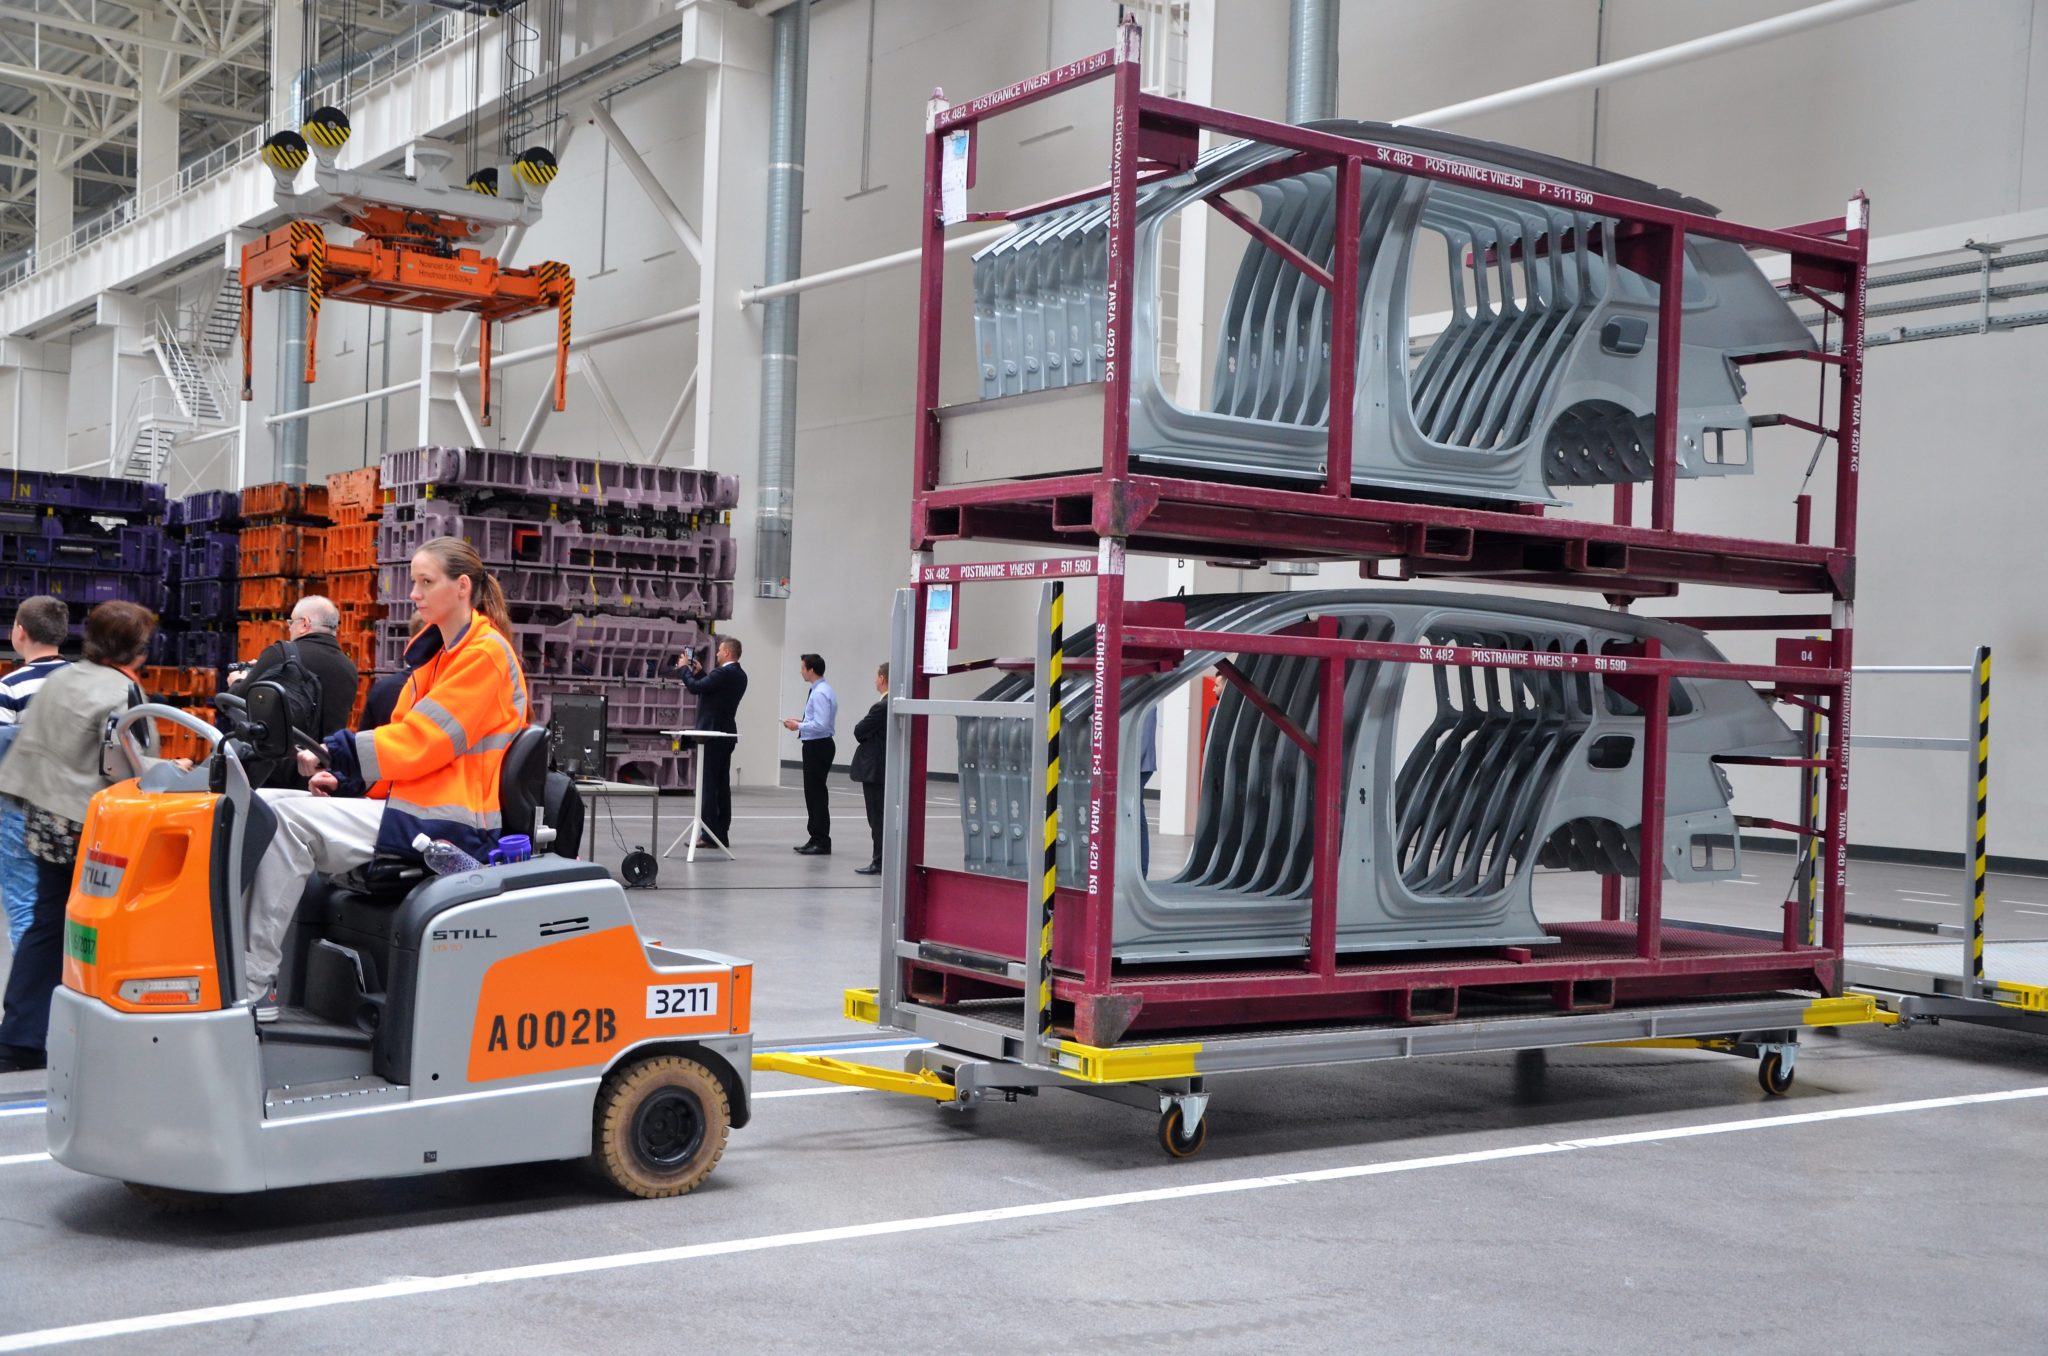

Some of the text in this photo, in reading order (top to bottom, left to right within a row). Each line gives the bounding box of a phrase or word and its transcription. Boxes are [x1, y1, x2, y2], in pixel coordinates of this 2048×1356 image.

[940, 111, 951, 124] SK
[952, 105, 967, 120] 482
[972, 84, 1021, 112] POSTRANICE
[1056, 70, 1064, 82] P
[1070, 62, 1087, 77] 511
[1089, 53, 1107, 71] 590
[1376, 147, 1390, 162] SK
[1392, 151, 1414, 167] 482
[1425, 158, 1488, 182] POSTRANICE
[1539, 183, 1546, 195] P
[1554, 187, 1572, 201] 511
[1575, 191, 1594, 206] 590
[1107, 280, 1117, 324] TARA
[1106, 328, 1116, 358] 420
[1106, 361, 1115, 382] KG
[1852, 392, 1861, 426] TARA
[1851, 429, 1860, 453] 420
[1850, 455, 1859, 472] KG
[20, 483, 31, 497] N
[924, 568, 934, 580] SK
[935, 567, 950, 580] 482
[960, 564, 1005, 578] POSTRANICE
[1042, 562, 1049, 574] P
[1061, 560, 1073, 573] 511
[1074, 559, 1091, 573] 590
[1419, 647, 1433, 661] SK
[1435, 649, 1454, 661] 482
[1471, 651, 1529, 666] POSTRANICE
[1570, 656, 1578, 668] P
[1594, 658, 1608, 670] 511
[1609, 659, 1627, 672] 590
[1801, 650, 1813, 662] 04
[1093, 623, 1106, 750] STOHOVATELNOST
[1090, 798, 1101, 834] TARA
[1838, 810, 1847, 839] TARA
[1089, 841, 1099, 870] 420
[1837, 844, 1847, 867] 420
[84, 866, 112, 889] TILL
[1088, 874, 1098, 895] KG
[1836, 870, 1846, 886] KG
[432, 928, 498, 940] STILL
[654, 986, 710, 1015] 3211
[487, 1007, 616, 1052] A002B
